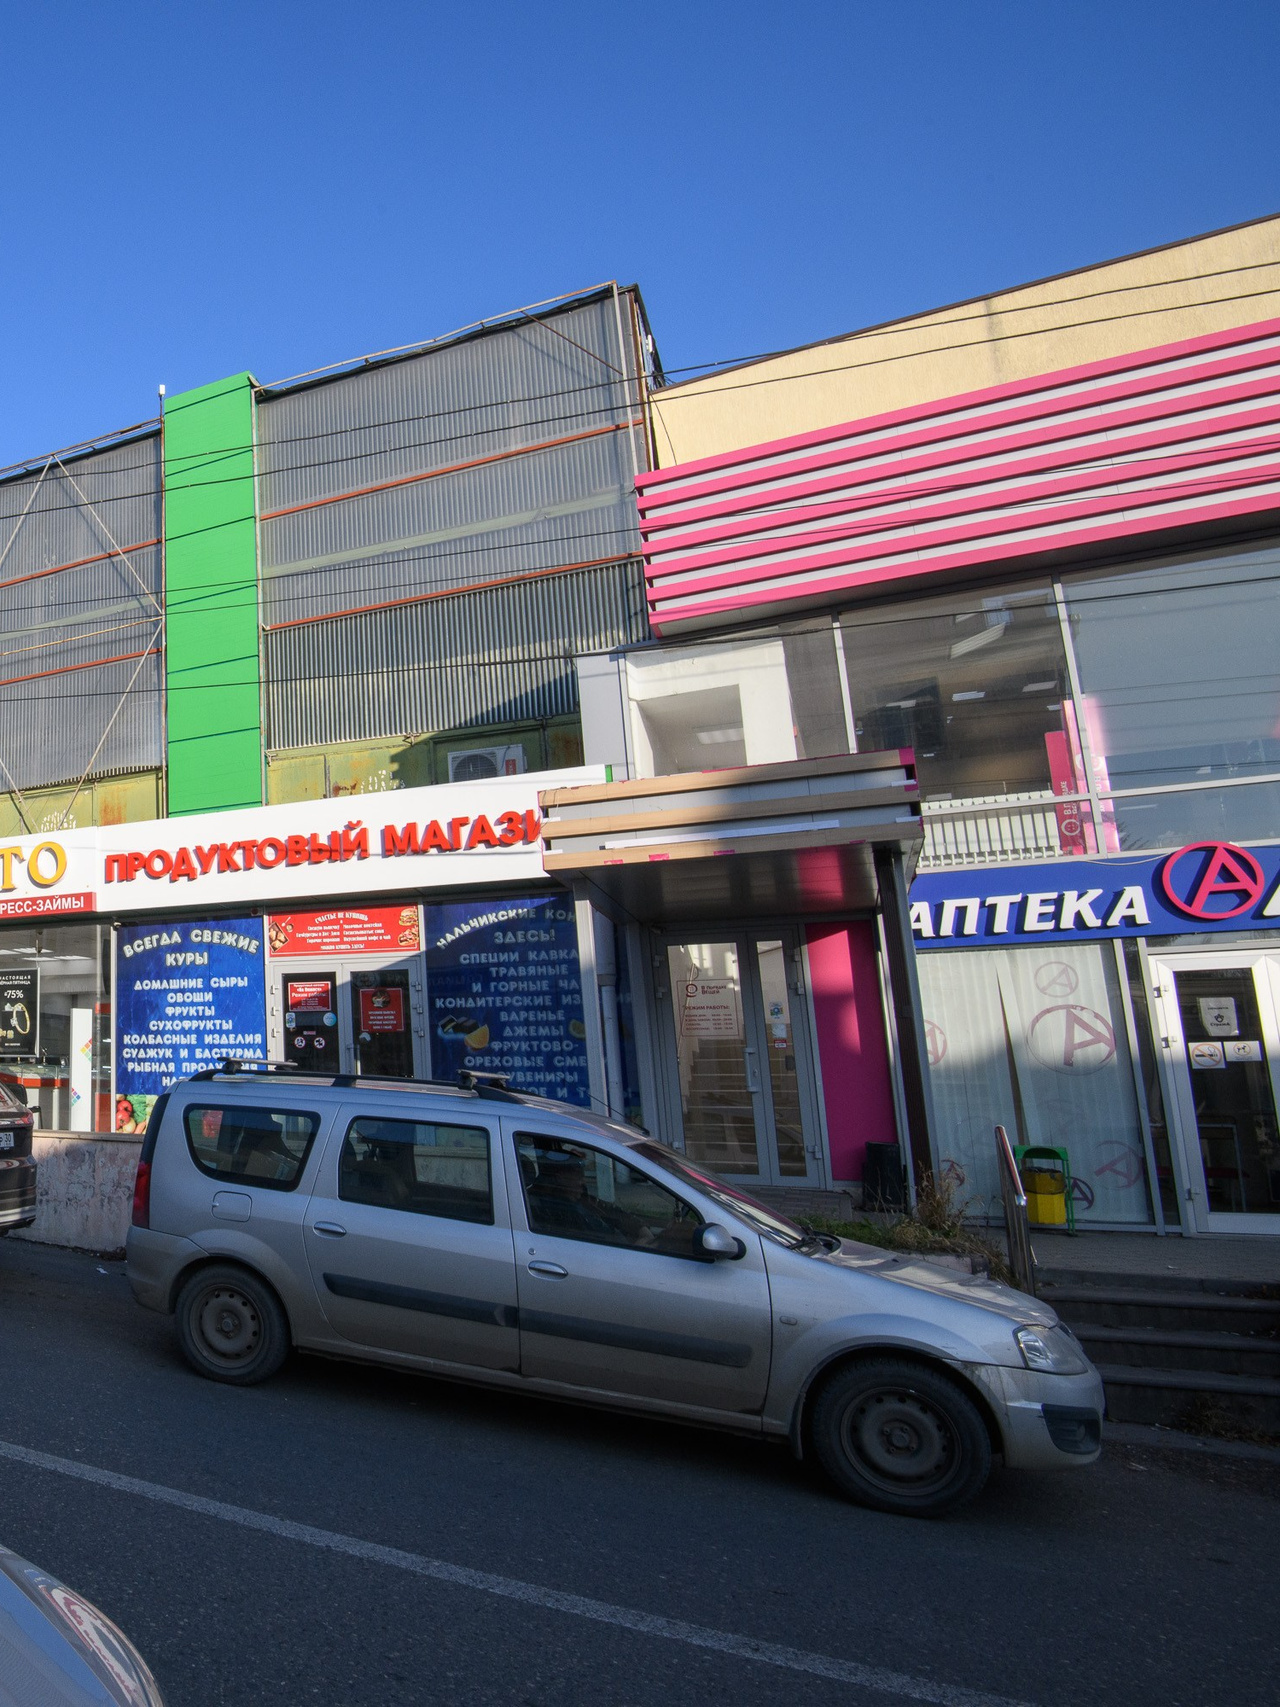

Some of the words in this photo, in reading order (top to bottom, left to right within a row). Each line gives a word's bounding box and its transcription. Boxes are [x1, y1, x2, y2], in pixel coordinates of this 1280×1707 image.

[105, 820, 370, 884] ПРОДУКТОВЫЙ
[910, 886, 1152, 938] АПТЕКА
[436, 908, 536, 950] НАЛЬЧИКСКИЕ
[494, 929, 556, 944] ЗДЕСЬ!
[123, 931, 182, 958] ВСЕГДА
[190, 929, 260, 955] СВЕЖИЕ
[165, 952, 209, 967] КУРЫ
[459, 951, 520, 965] СПЕЦИИ
[489, 964, 569, 977] ТРАВЯНЫЕ
[134, 978, 204, 991] ДОМАШНИЕ
[210, 976, 248, 988] СЫРЫ
[472, 982, 482, 993] И
[490, 980, 550, 992] ГОРНЫЕ
[435, 995, 553, 1009] КОНДИТЕРСКИЕ
[165, 1005, 215, 1017] ФРУКТЫ
[500, 1010, 566, 1022] ВАРЕНЬЕ
[149, 1019, 233, 1032] СУХОФРУКТЫ
[503, 1024, 564, 1037] ДЖЕМЫ
[123, 1034, 197, 1046] КОЛБАСНЫЕ
[204, 1034, 262, 1045] ИЗДЕЛИЯ
[490, 1041, 579, 1052] ФРУКТОВО-
[122, 1048, 173, 1059] СУДЖУК
[180, 1048, 188, 1058] И
[195, 1048, 263, 1059] БАСТУРМА
[127, 1062, 176, 1073] РЫБНАЯ
[182, 1062, 258, 1073] ПРОДУИЯ
[464, 1056, 545, 1068] ОРЕХОВЫЕ
